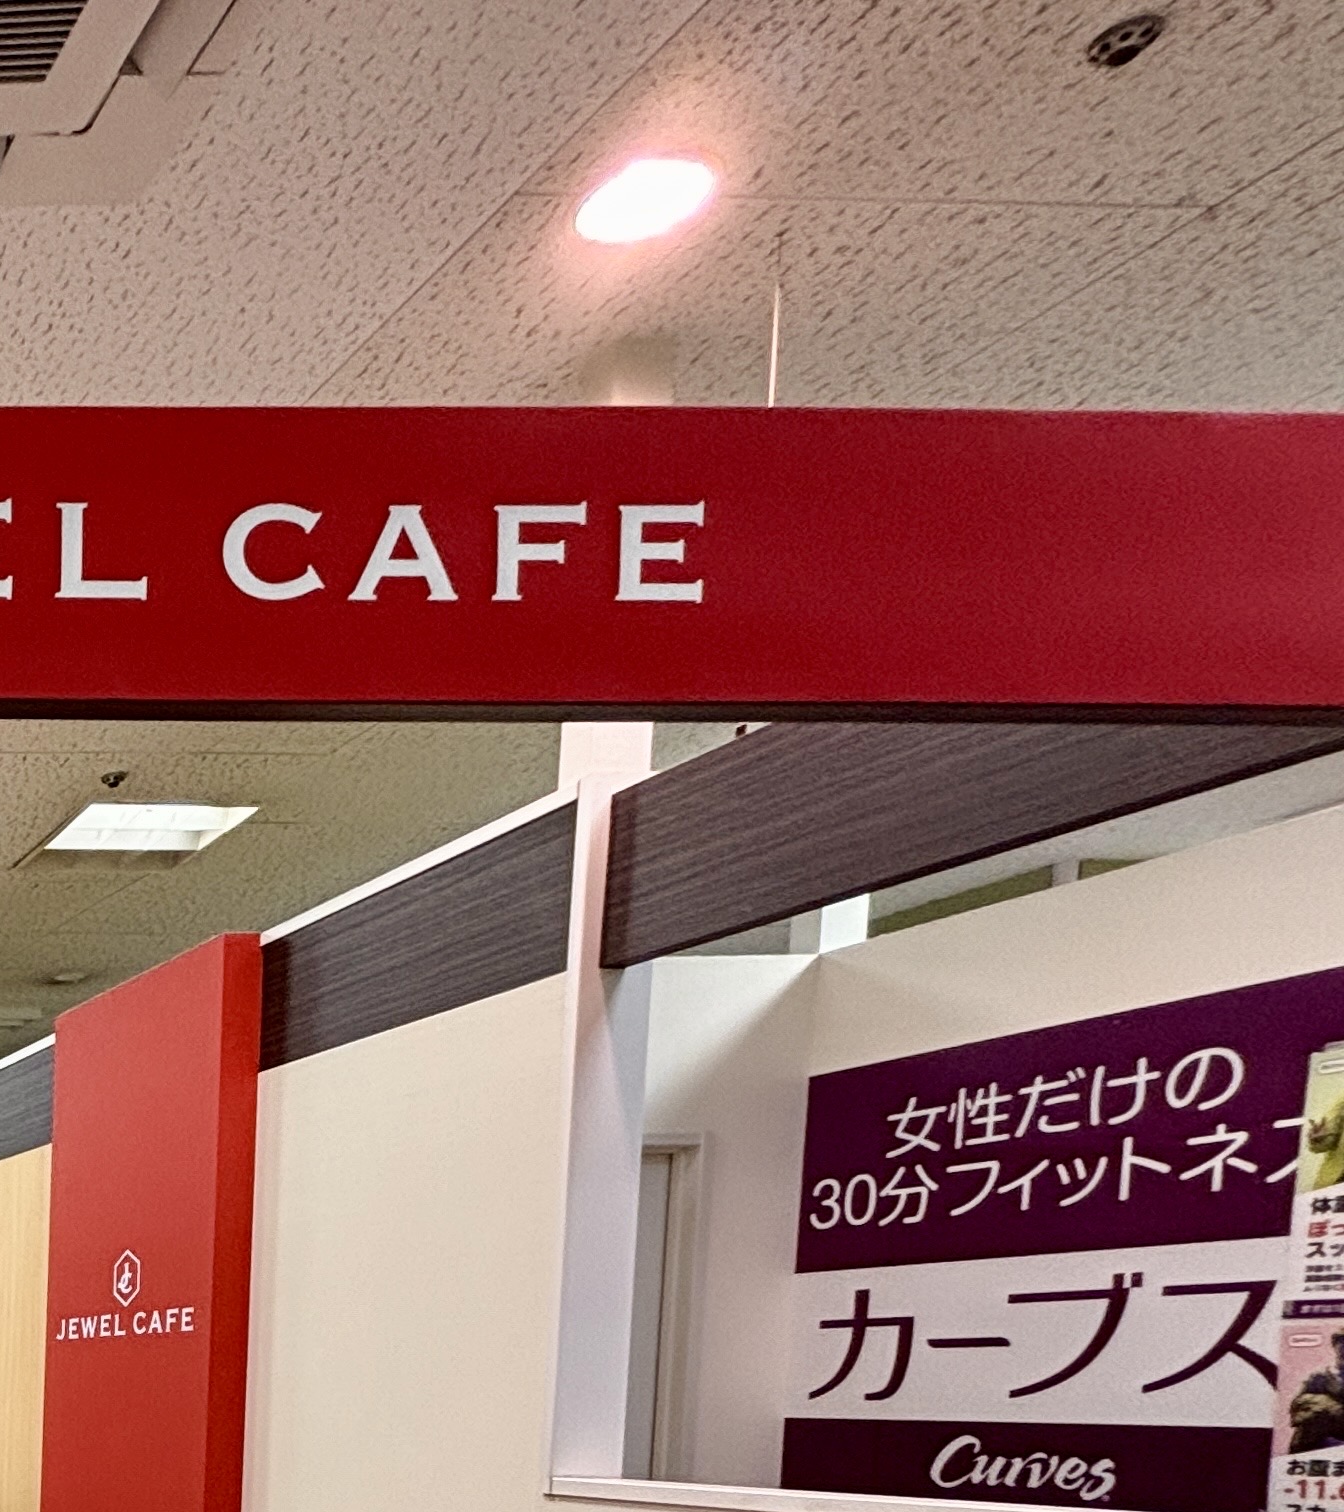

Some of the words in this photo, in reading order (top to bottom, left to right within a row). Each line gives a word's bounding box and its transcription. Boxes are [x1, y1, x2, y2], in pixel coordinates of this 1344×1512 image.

[221, 500, 706, 603] CAFE
[885, 1047, 1245, 1159] 女性だけの
[56, 1314, 126, 1341] JEWEL
[132, 1307, 194, 1334] CAFE
[808, 1272, 1279, 1401] カーブス
[928, 1434, 1117, 1501] Curves
